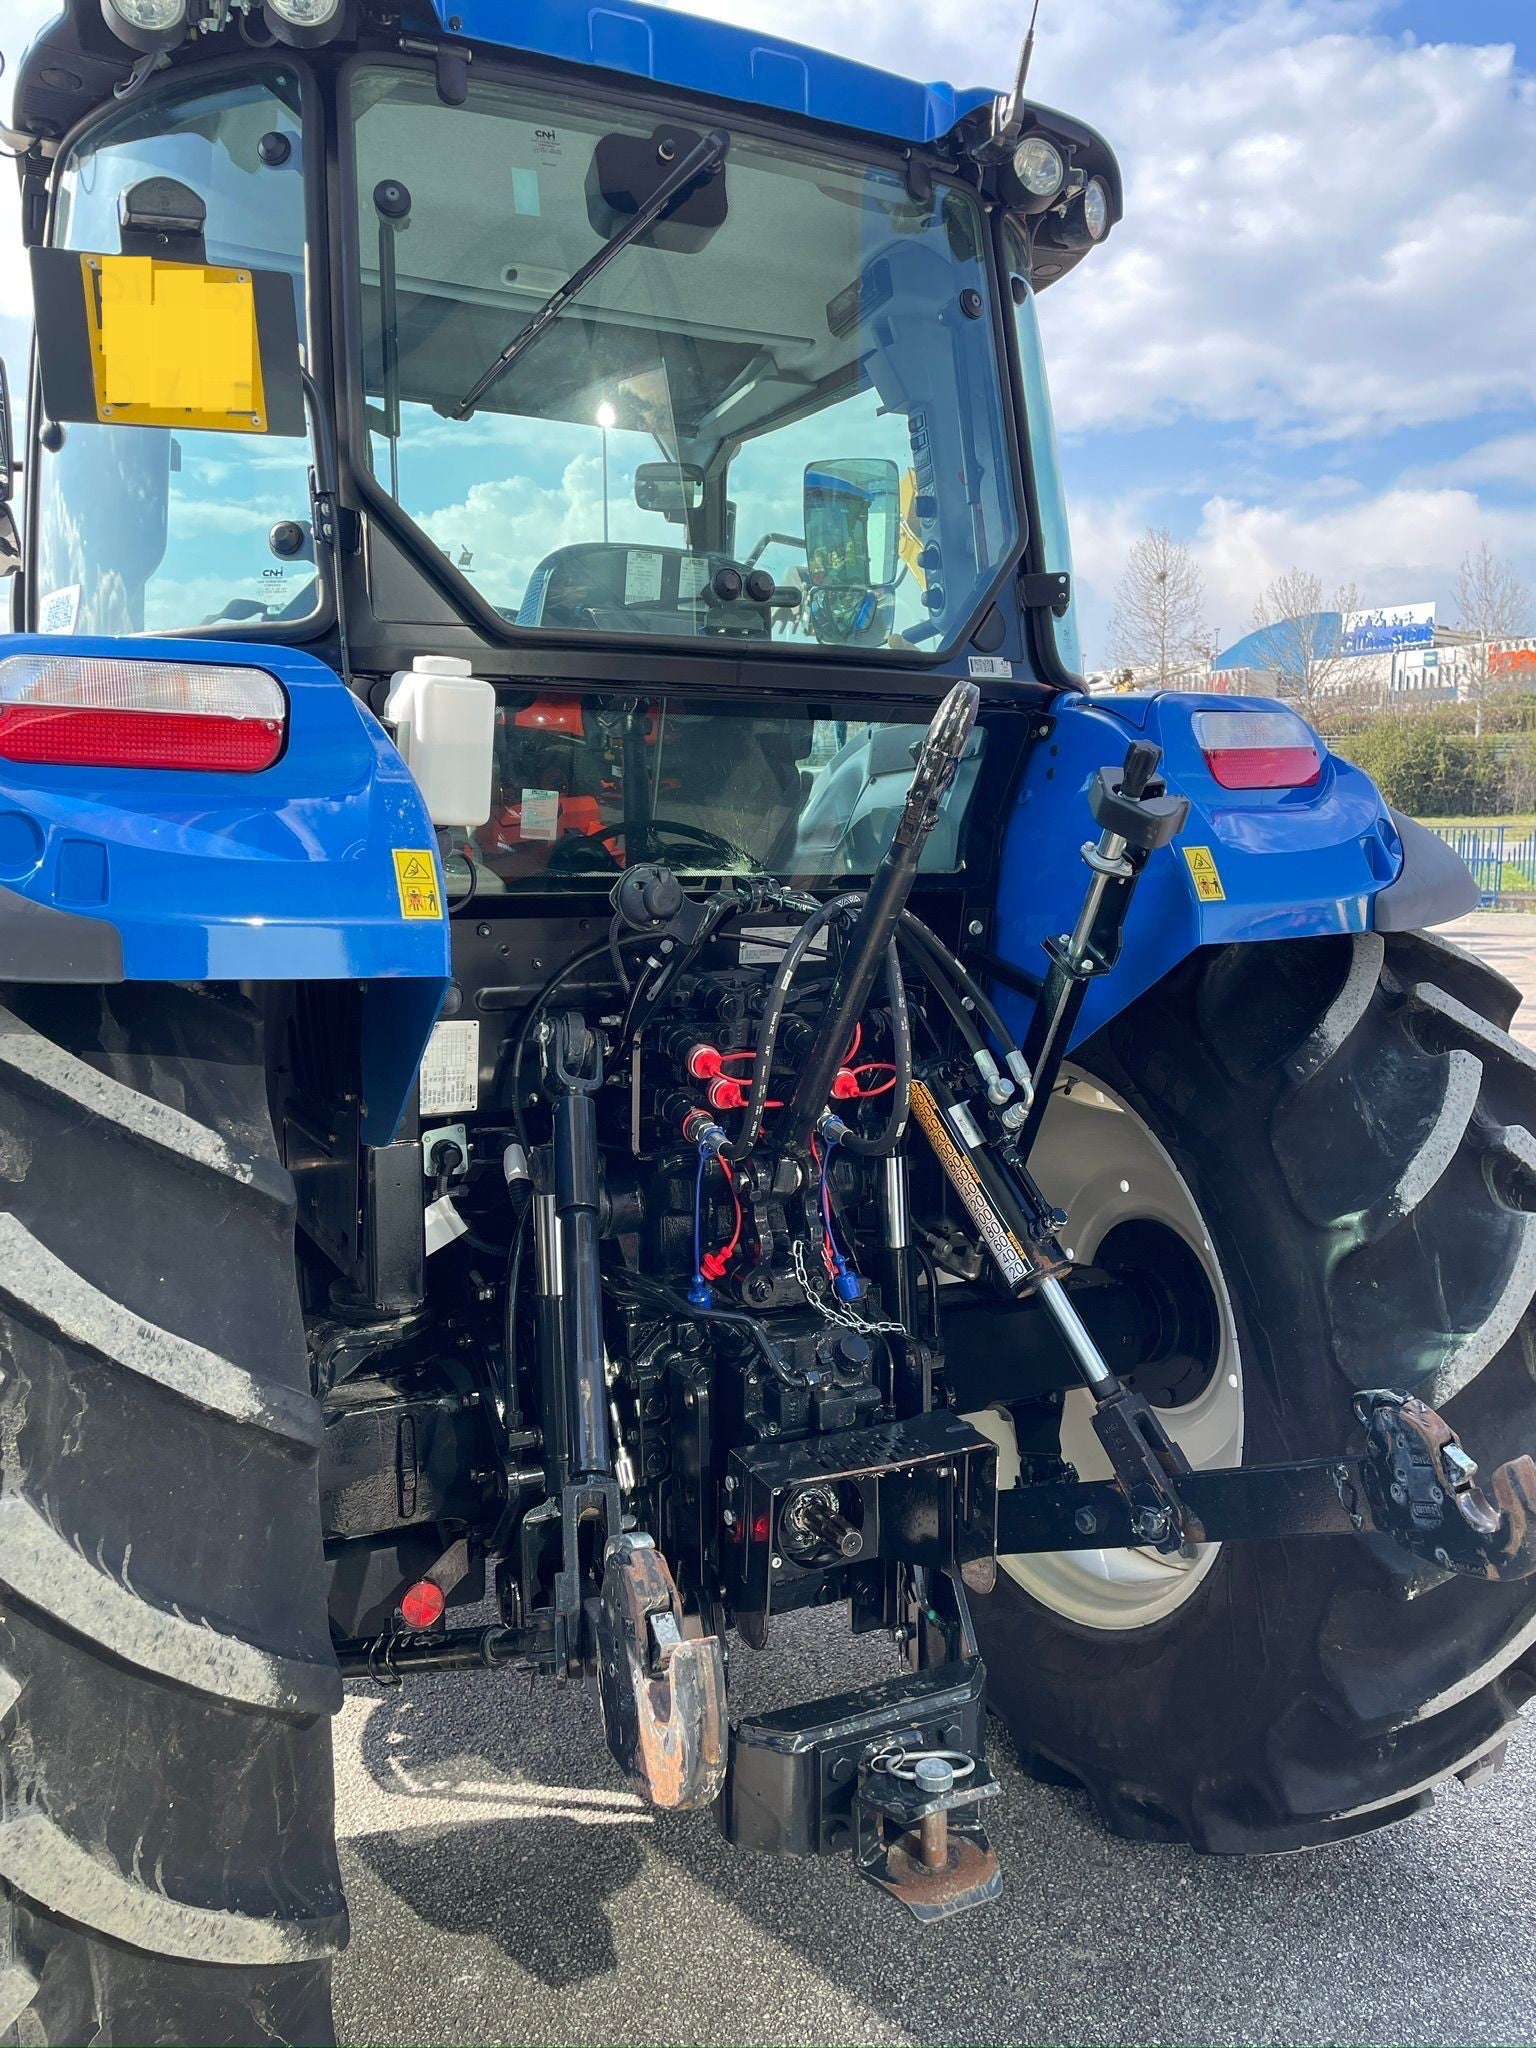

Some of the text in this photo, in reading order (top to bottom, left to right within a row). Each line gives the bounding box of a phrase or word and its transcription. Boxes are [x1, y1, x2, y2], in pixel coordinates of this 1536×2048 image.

[985, 1221, 1001, 1239] 80
[993, 1235, 1009, 1252] 60
[1002, 1248, 1017, 1264] 40
[1009, 1261, 1025, 1280] 20
